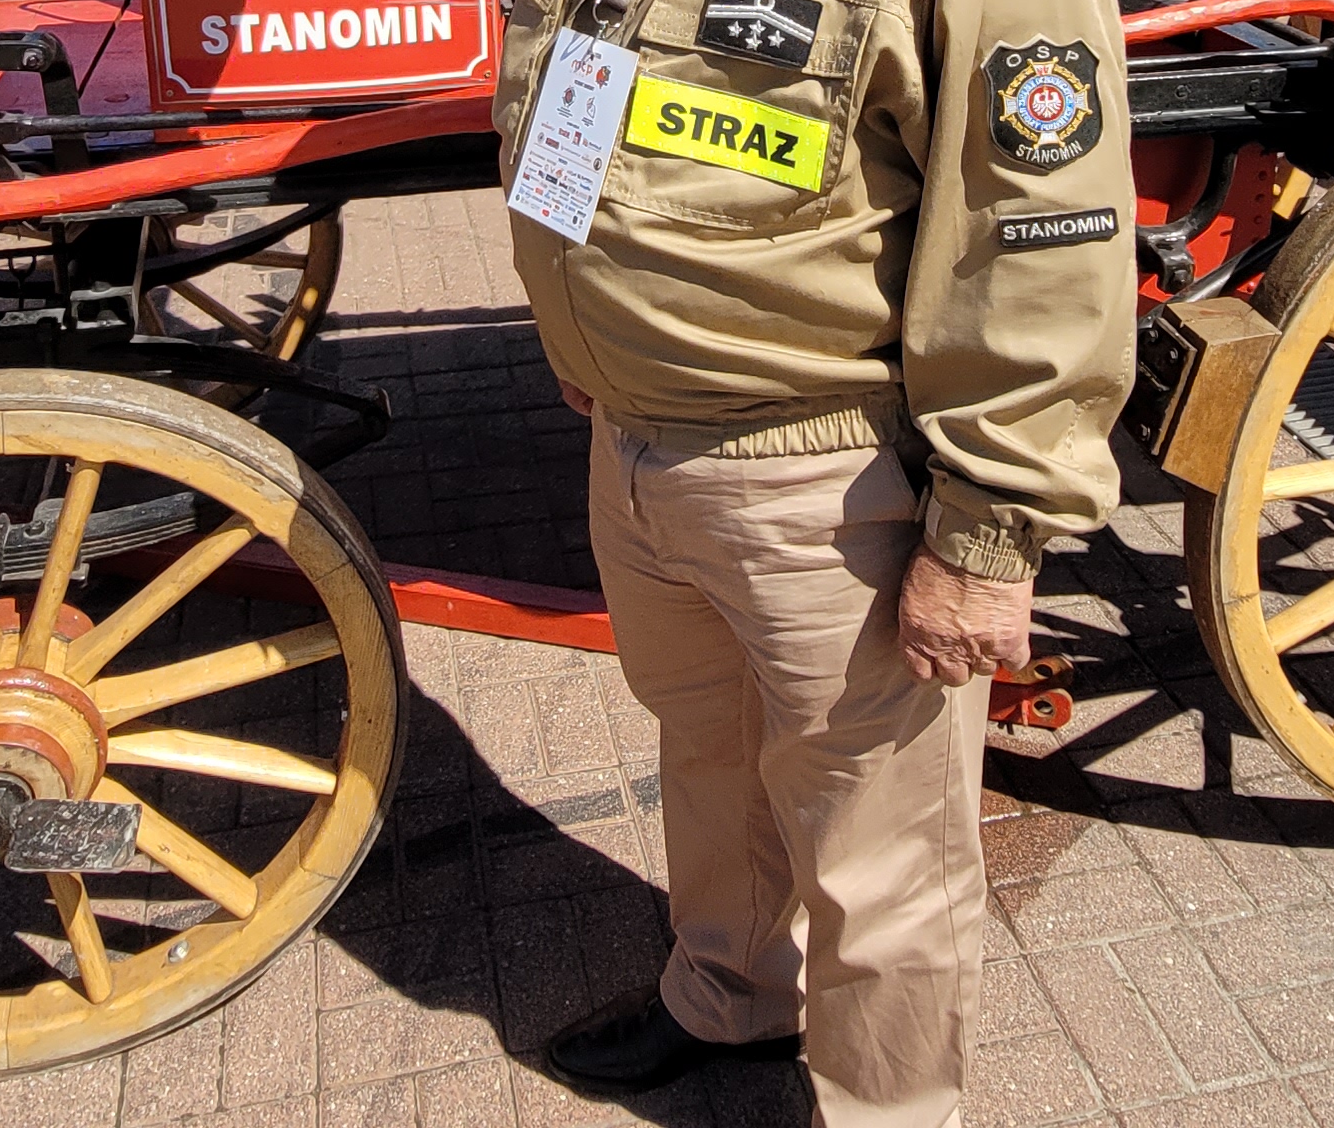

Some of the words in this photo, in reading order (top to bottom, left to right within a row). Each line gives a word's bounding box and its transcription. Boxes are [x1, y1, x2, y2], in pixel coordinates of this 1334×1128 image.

[201, 4, 453, 55] STANOMIN
[1015, 139, 1084, 164] STANOMIN
[1002, 214, 1115, 241] STANOMIN
